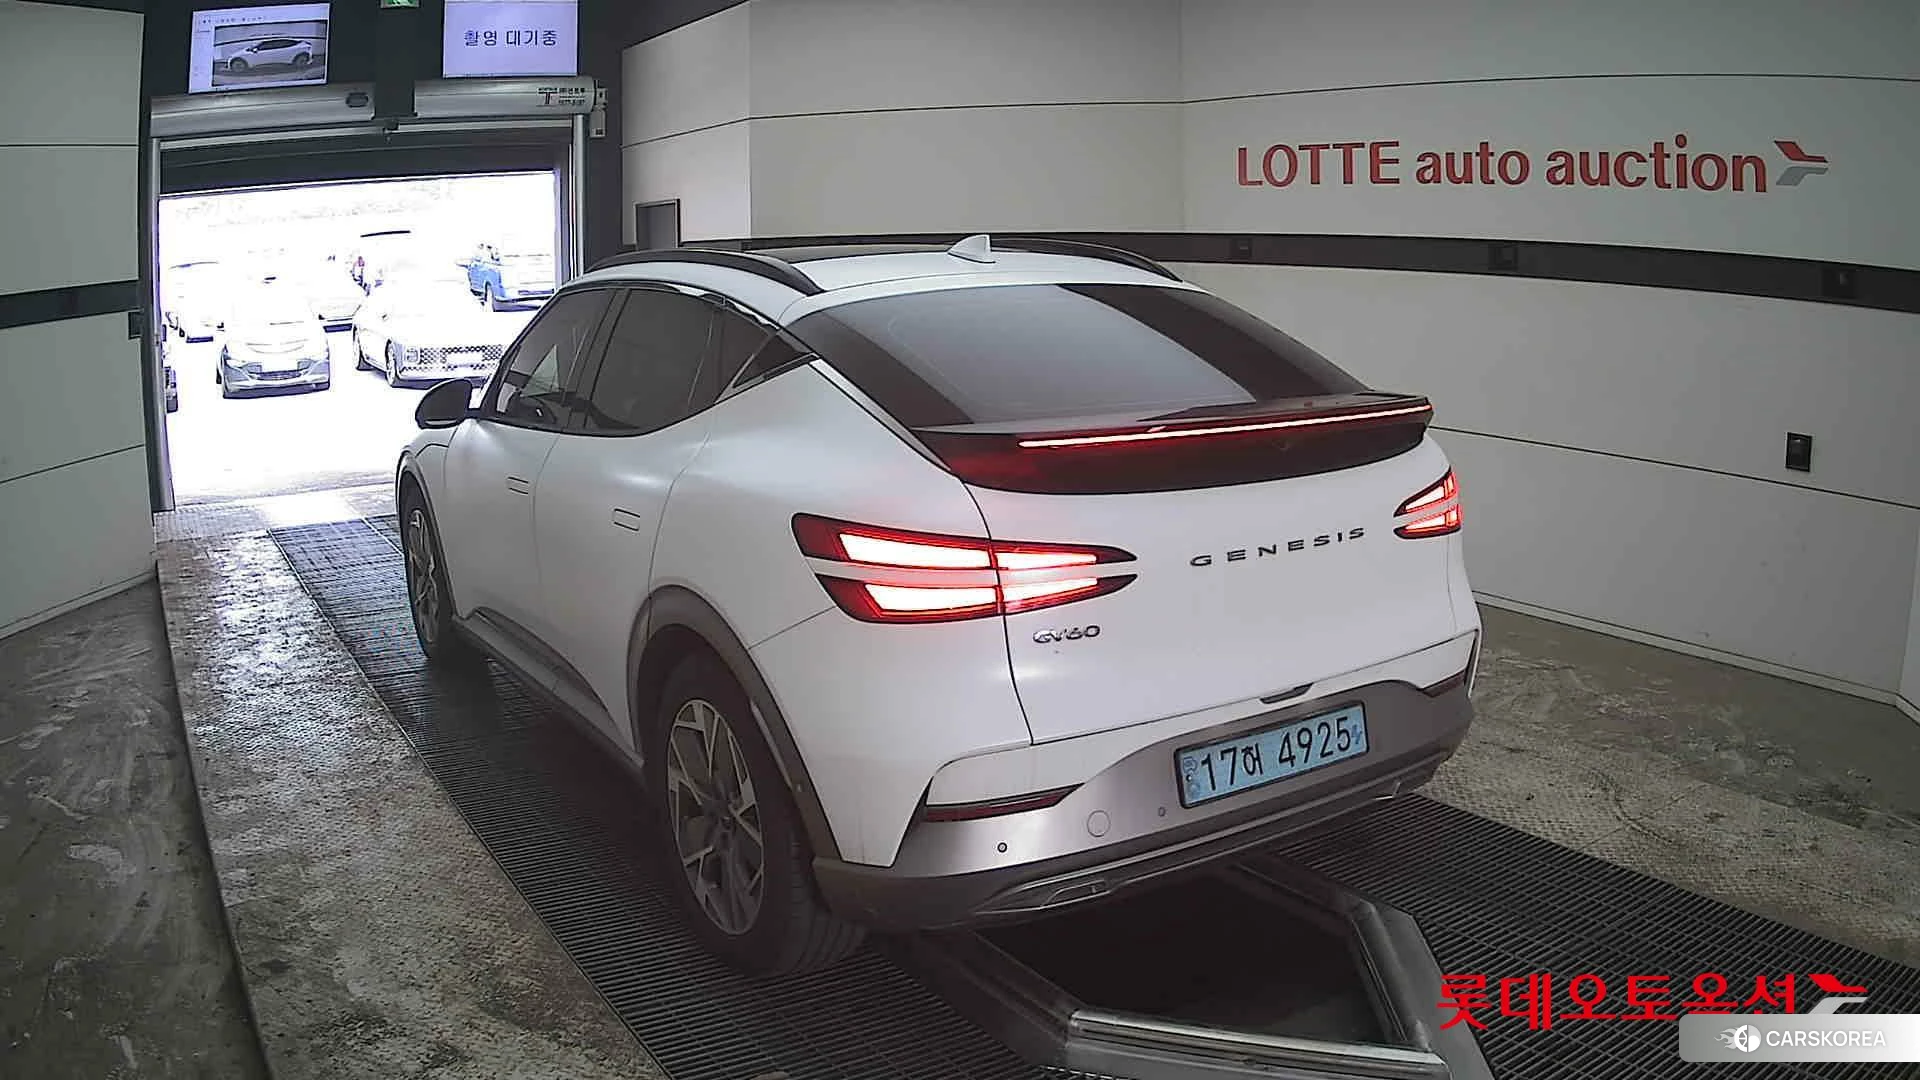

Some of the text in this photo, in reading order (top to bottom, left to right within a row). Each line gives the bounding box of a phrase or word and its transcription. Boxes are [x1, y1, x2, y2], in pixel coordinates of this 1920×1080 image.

[464, 29, 557, 46] 촬영 대기중
[1238, 134, 1768, 193] LOTTE auto auction
[1190, 527, 1364, 567] GENESIS
[1032, 625, 1100, 644] GV60
[1278, 716, 1351, 768] 4925
